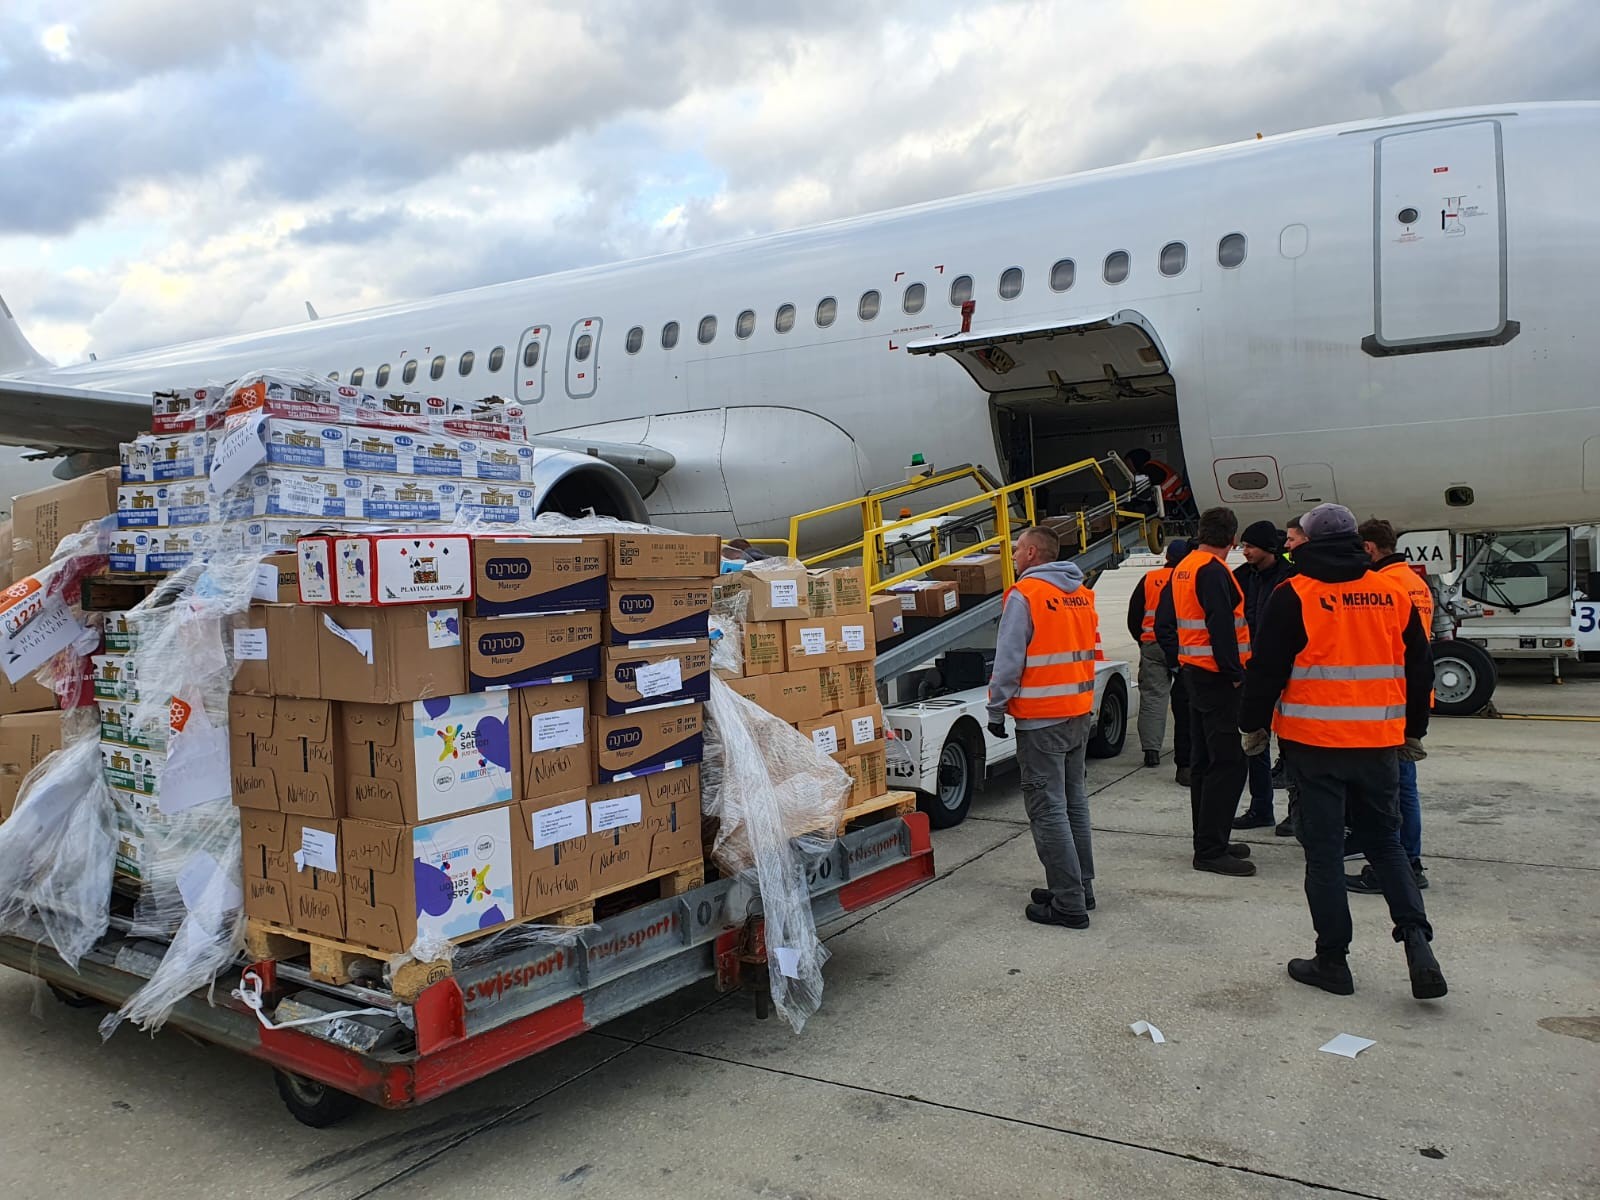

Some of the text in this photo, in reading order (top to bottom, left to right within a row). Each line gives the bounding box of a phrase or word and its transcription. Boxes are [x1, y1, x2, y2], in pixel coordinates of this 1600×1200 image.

[430, 584, 452, 592] CARDS
[1062, 596, 1090, 606] MEHOLA
[1342, 592, 1394, 607] MEHOLA
[13, 598, 43, 630] 1221
[1578, 606, 1600, 633] 3
[460, 730, 482, 741] SASA
[356, 784, 393, 801] Nutrilon
[590, 916, 671, 961] swissport
[466, 951, 565, 1003] swissport
